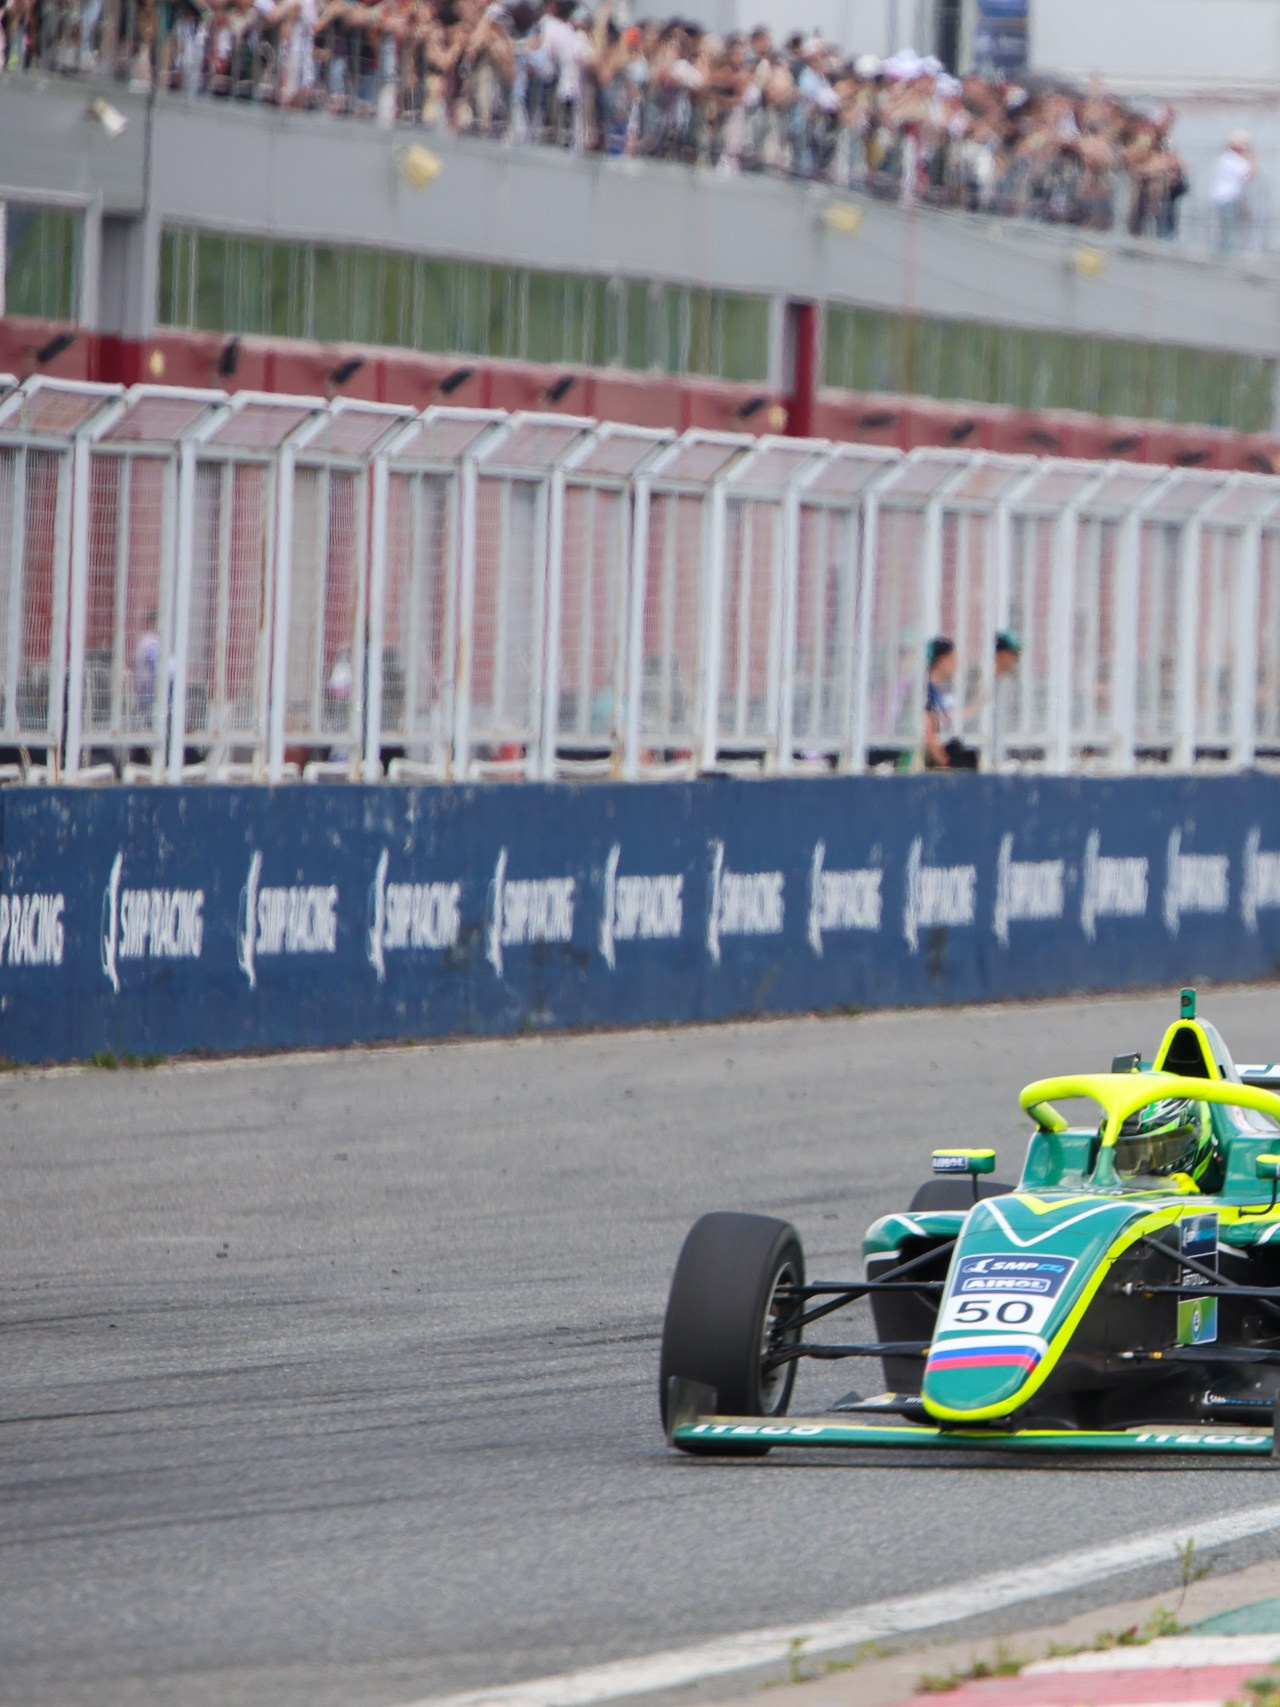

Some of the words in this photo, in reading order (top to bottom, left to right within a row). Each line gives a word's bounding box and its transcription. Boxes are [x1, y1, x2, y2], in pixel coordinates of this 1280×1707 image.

[991, 1261, 1040, 1271] SMP
[967, 1279, 1044, 1289] AIMOL
[953, 1300, 1034, 1324] 50
[692, 1424, 825, 1436] ITECO
[1136, 1434, 1267, 1444] ITECO
